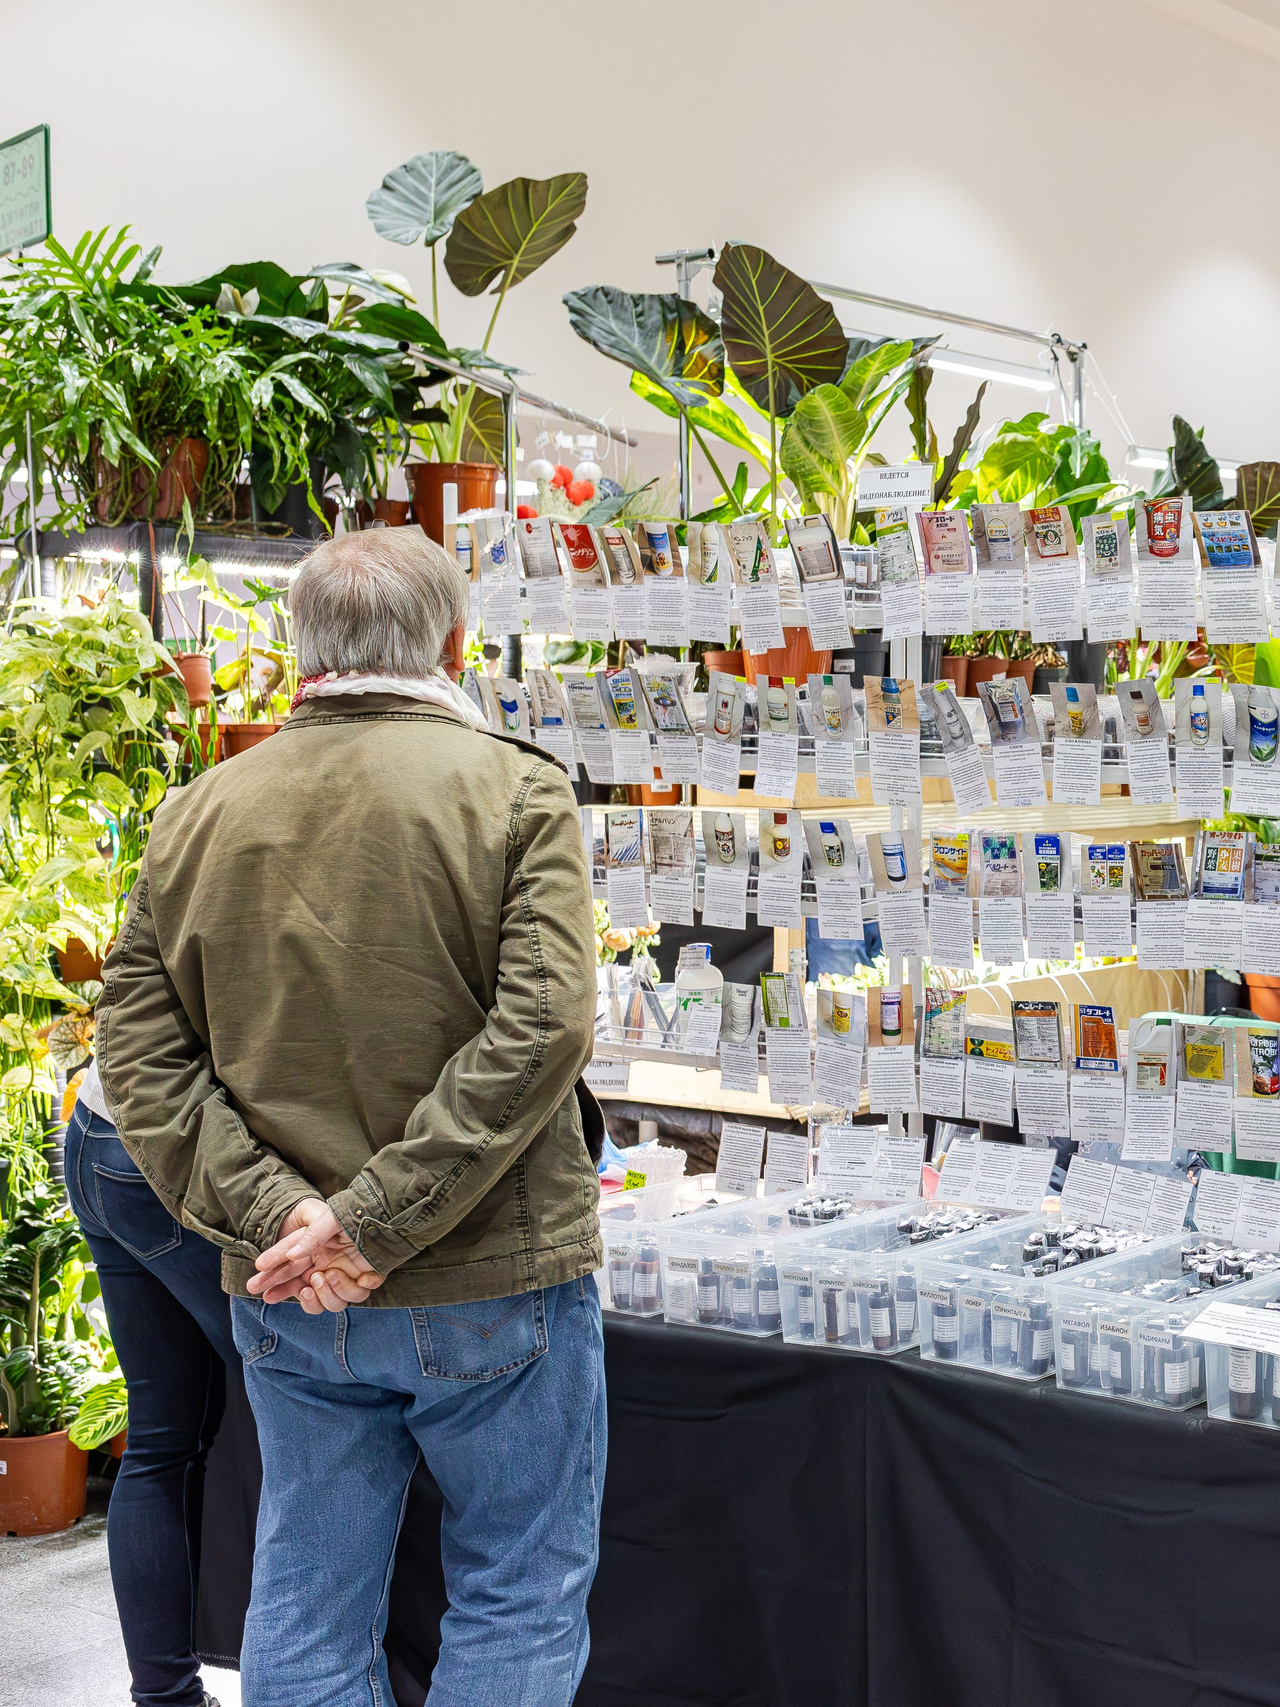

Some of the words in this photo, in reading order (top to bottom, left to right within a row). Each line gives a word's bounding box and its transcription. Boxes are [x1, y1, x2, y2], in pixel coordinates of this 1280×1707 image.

[879, 471, 910, 480] ВЕДЕТСЯ
[859, 489, 927, 500] ВИДЕОНАБЛЮДЕНИЕ
[1206, 847, 1217, 872] 野菜
[1250, 1046, 1278, 1057] STROBY
[919, 1289, 949, 1302] ФИЛЛОТОН
[964, 1298, 983, 1309] ЛОКЕР
[994, 1304, 1028, 1319] СПРИНТАЛГА
[1062, 1318, 1091, 1329] МЕГАФОЛ
[1099, 1323, 1129, 1335] ИЗАБИОН
[1138, 1332, 1172, 1346] РАДИФАРМ
